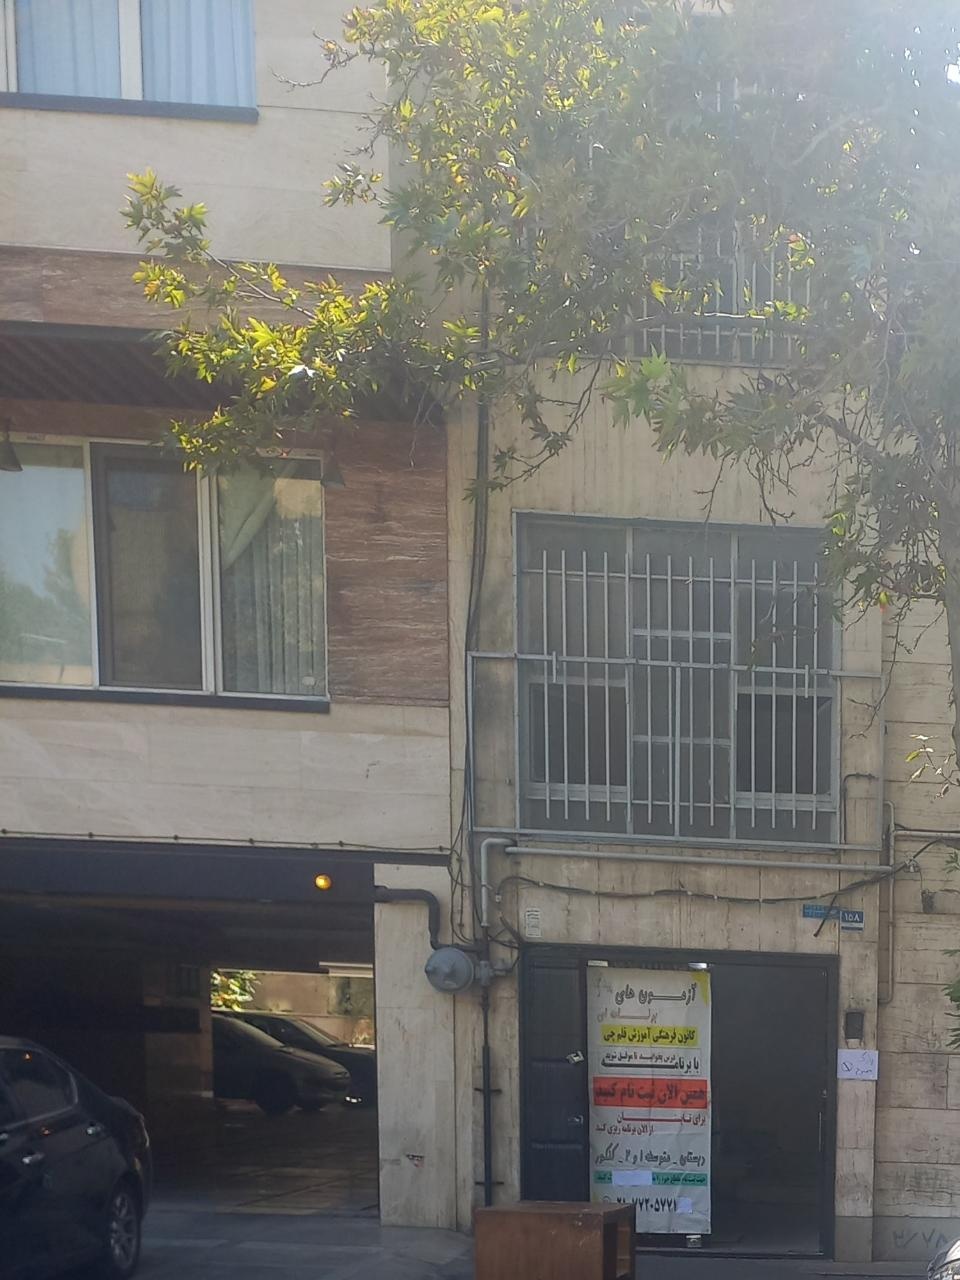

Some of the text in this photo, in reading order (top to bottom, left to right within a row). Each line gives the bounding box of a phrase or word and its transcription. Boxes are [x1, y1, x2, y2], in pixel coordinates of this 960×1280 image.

[614, 983, 635, 1006] های
[639, 982, 697, 1006] آزمون
[603, 1026, 696, 1044] کانون فرهنگی آموزش قلم چی
[600, 1056, 700, 1074] با برنامه
[621, 1082, 636, 1104] نام
[693, 1113, 706, 1127] برای
[595, 1142, 620, 1165] کنکور
[645, 1150, 671, 1166] متوسطه
[679, 1151, 706, 1168] دبستان
